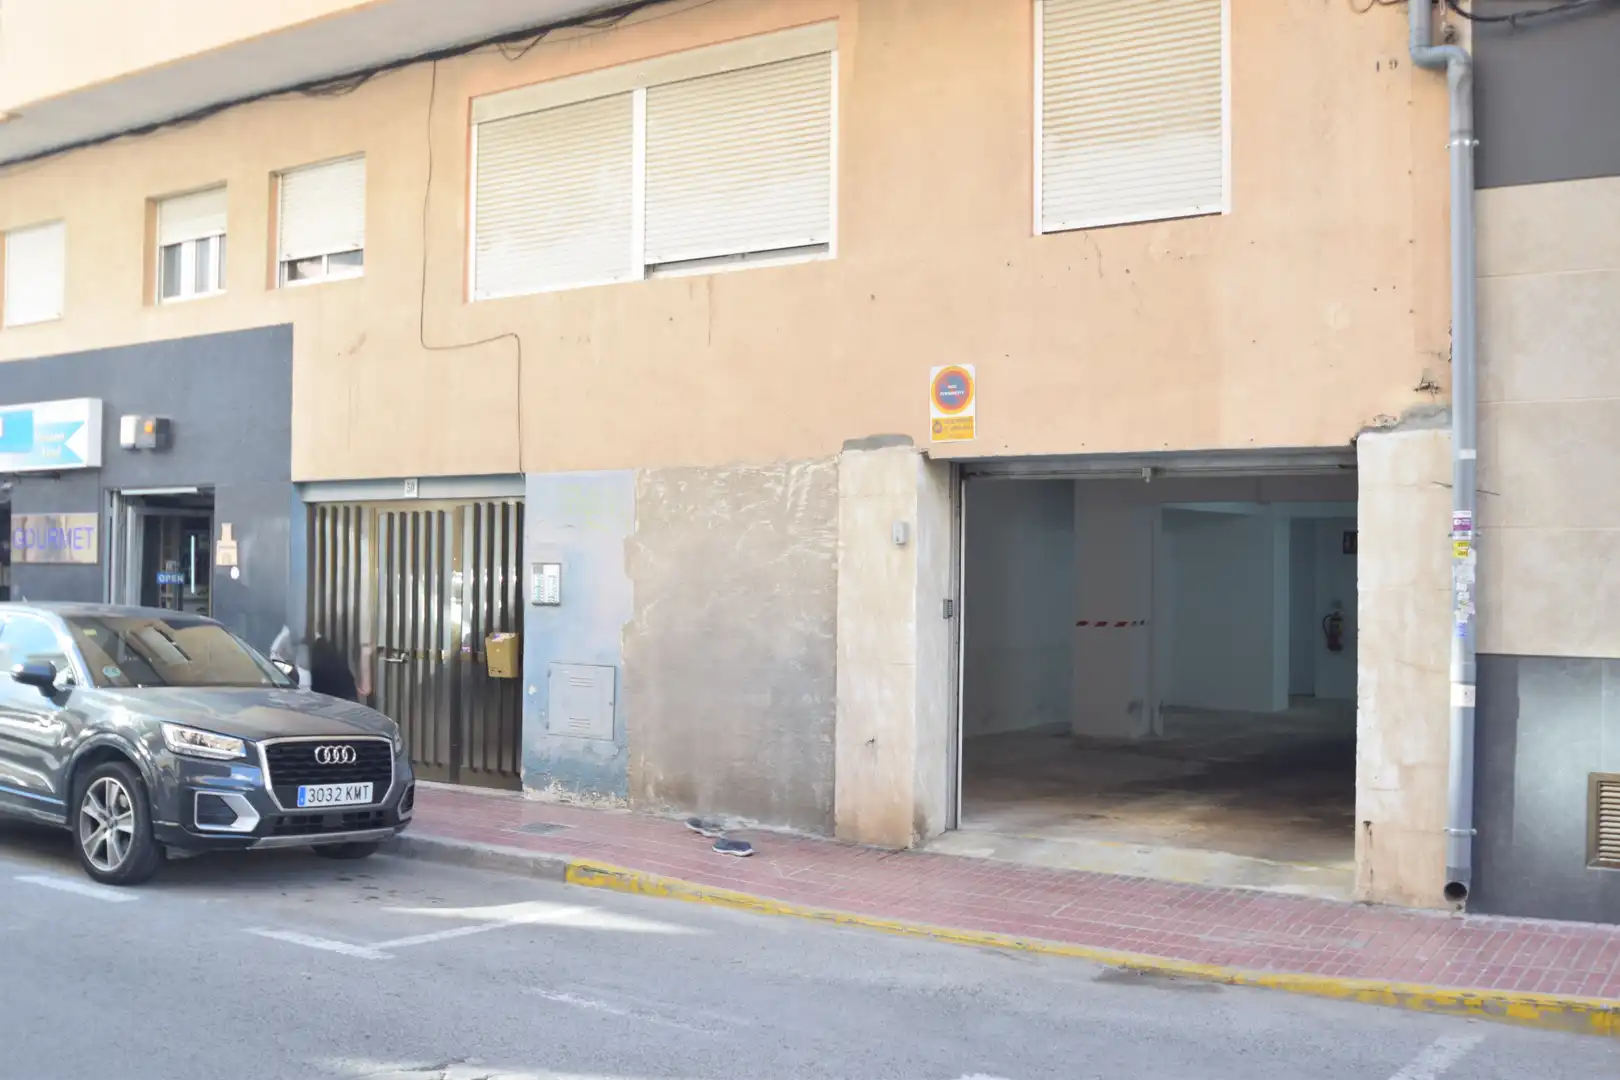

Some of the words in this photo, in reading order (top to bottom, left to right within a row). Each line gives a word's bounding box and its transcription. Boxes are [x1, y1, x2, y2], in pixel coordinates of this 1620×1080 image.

[12, 526, 95, 551] GOURMET
[158, 573, 184, 584] OPEN
[308, 787, 342, 803] 3032
[346, 785, 369, 801] KMT
